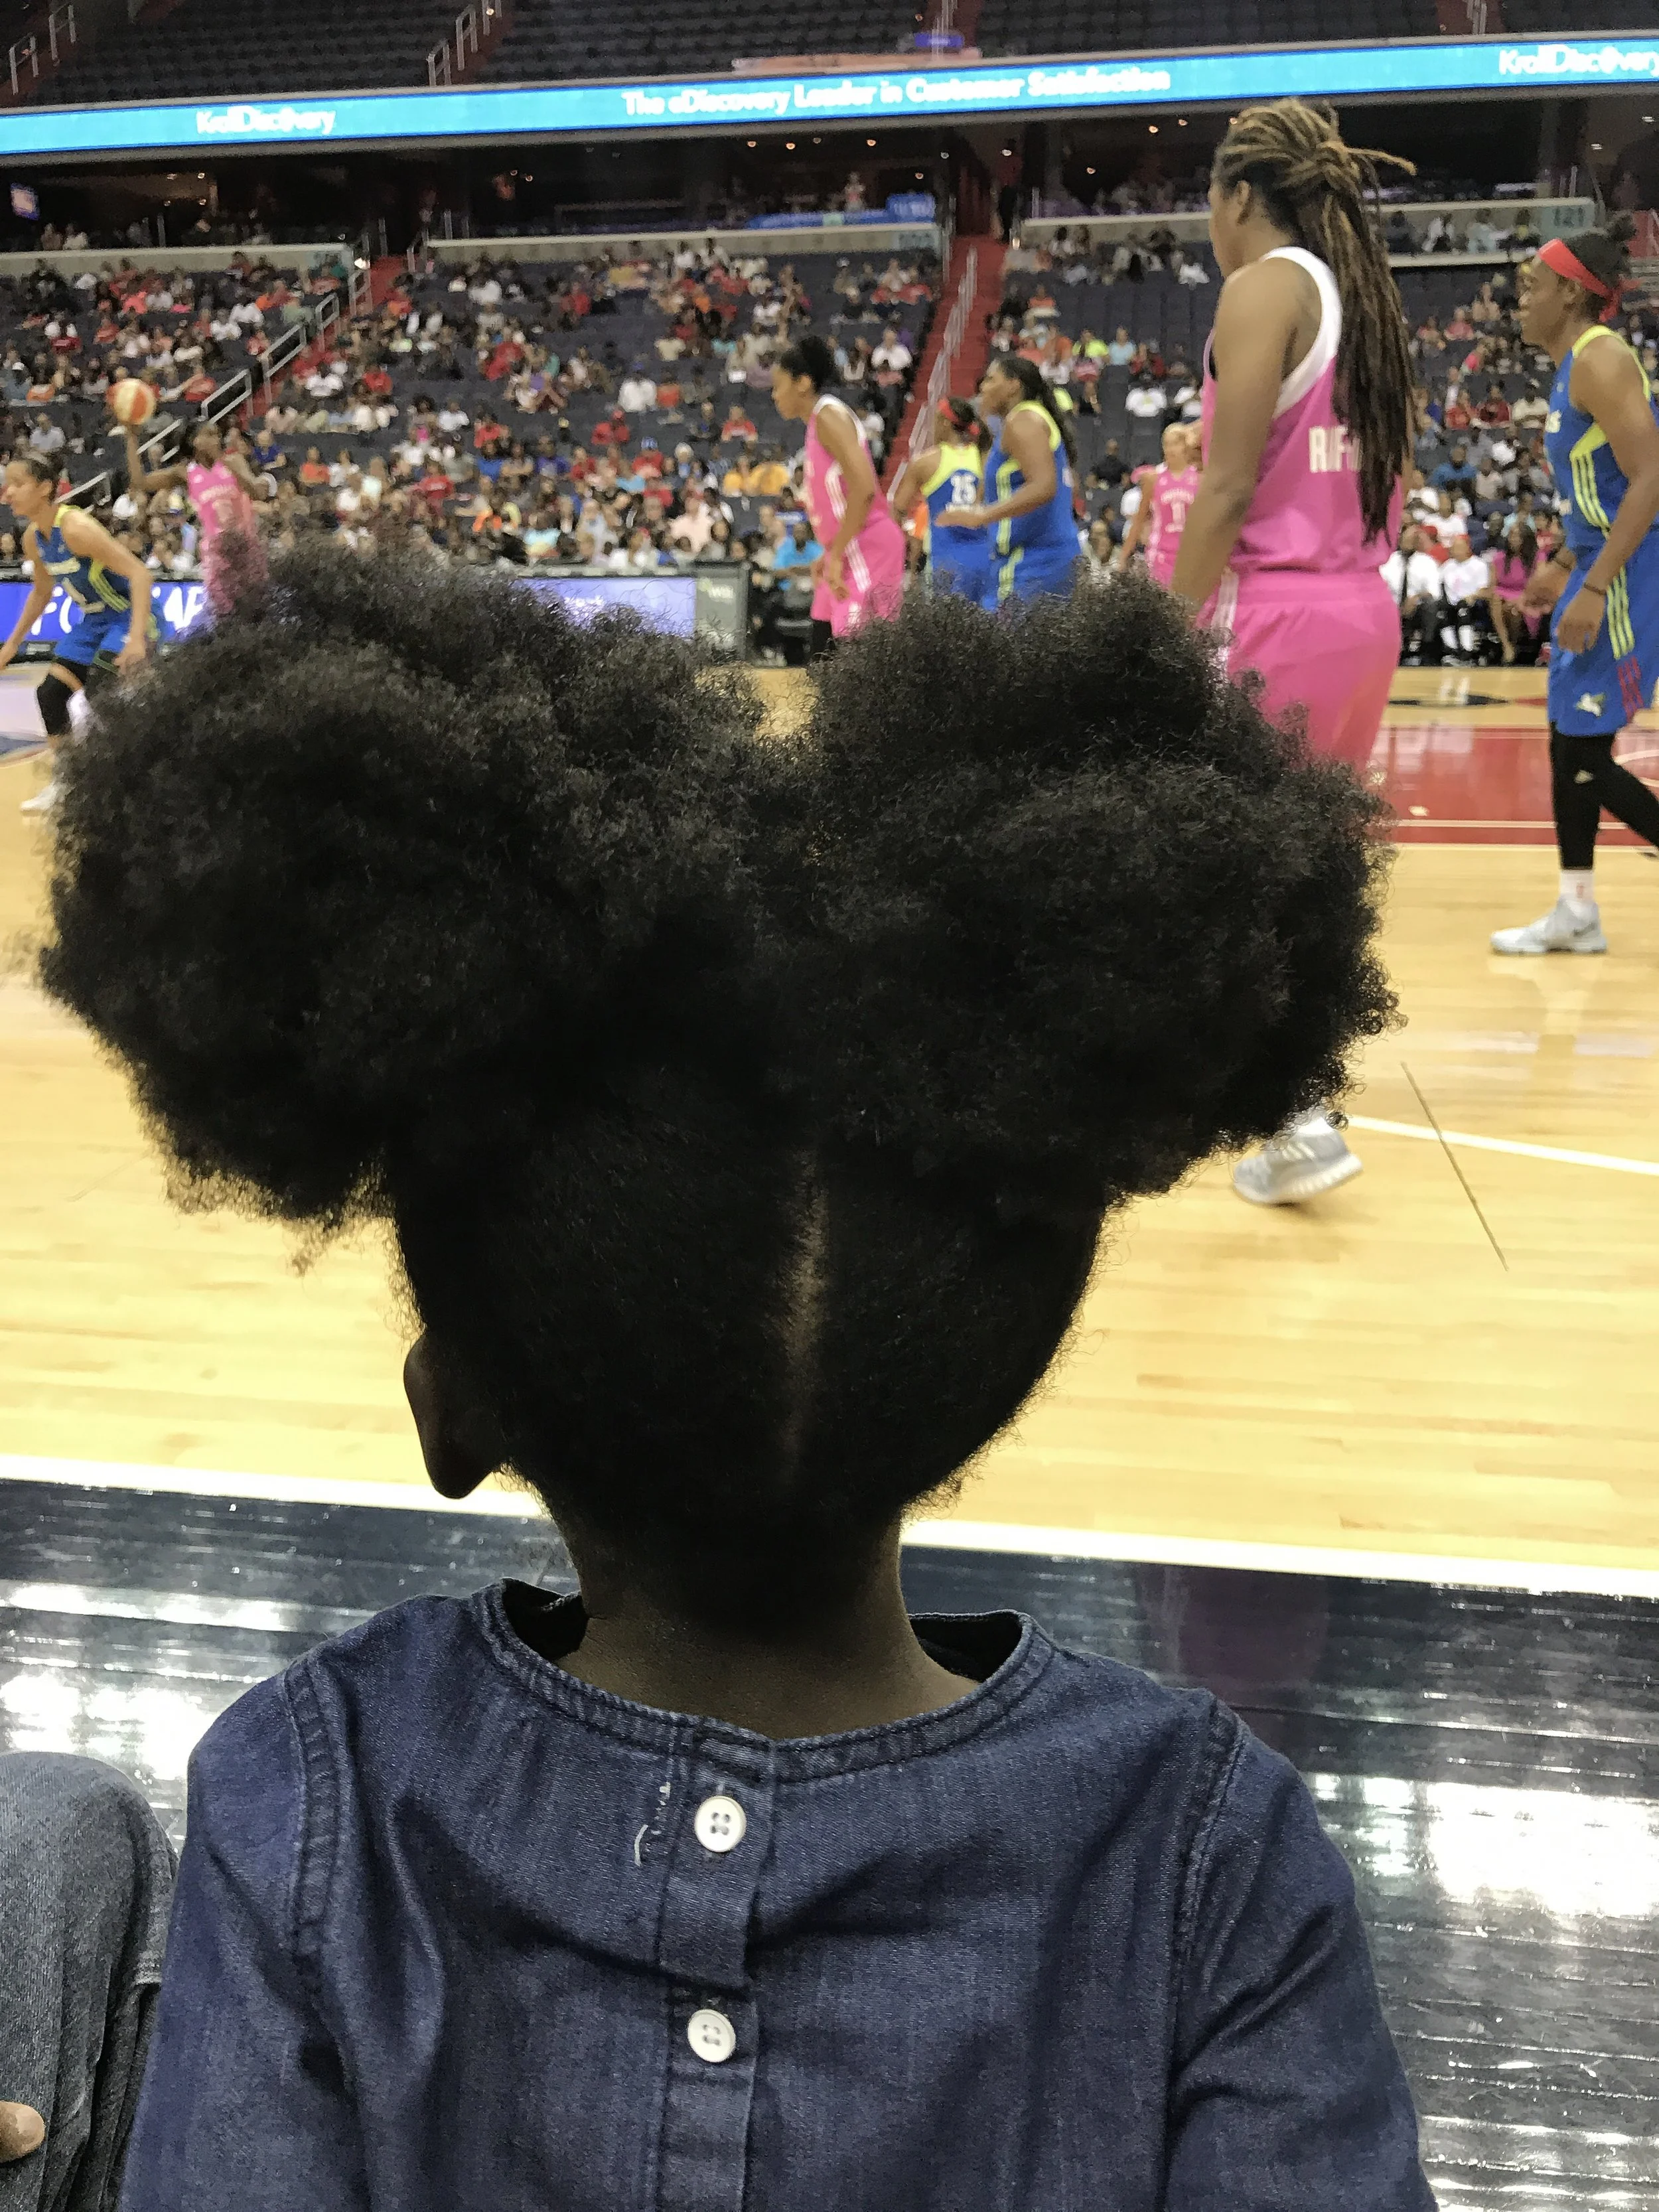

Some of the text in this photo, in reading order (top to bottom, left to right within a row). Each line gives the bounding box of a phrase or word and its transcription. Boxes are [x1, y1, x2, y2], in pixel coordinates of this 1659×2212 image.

[622, 67, 1171, 115] The eDiscovery Leader in Customer Satisfaction
